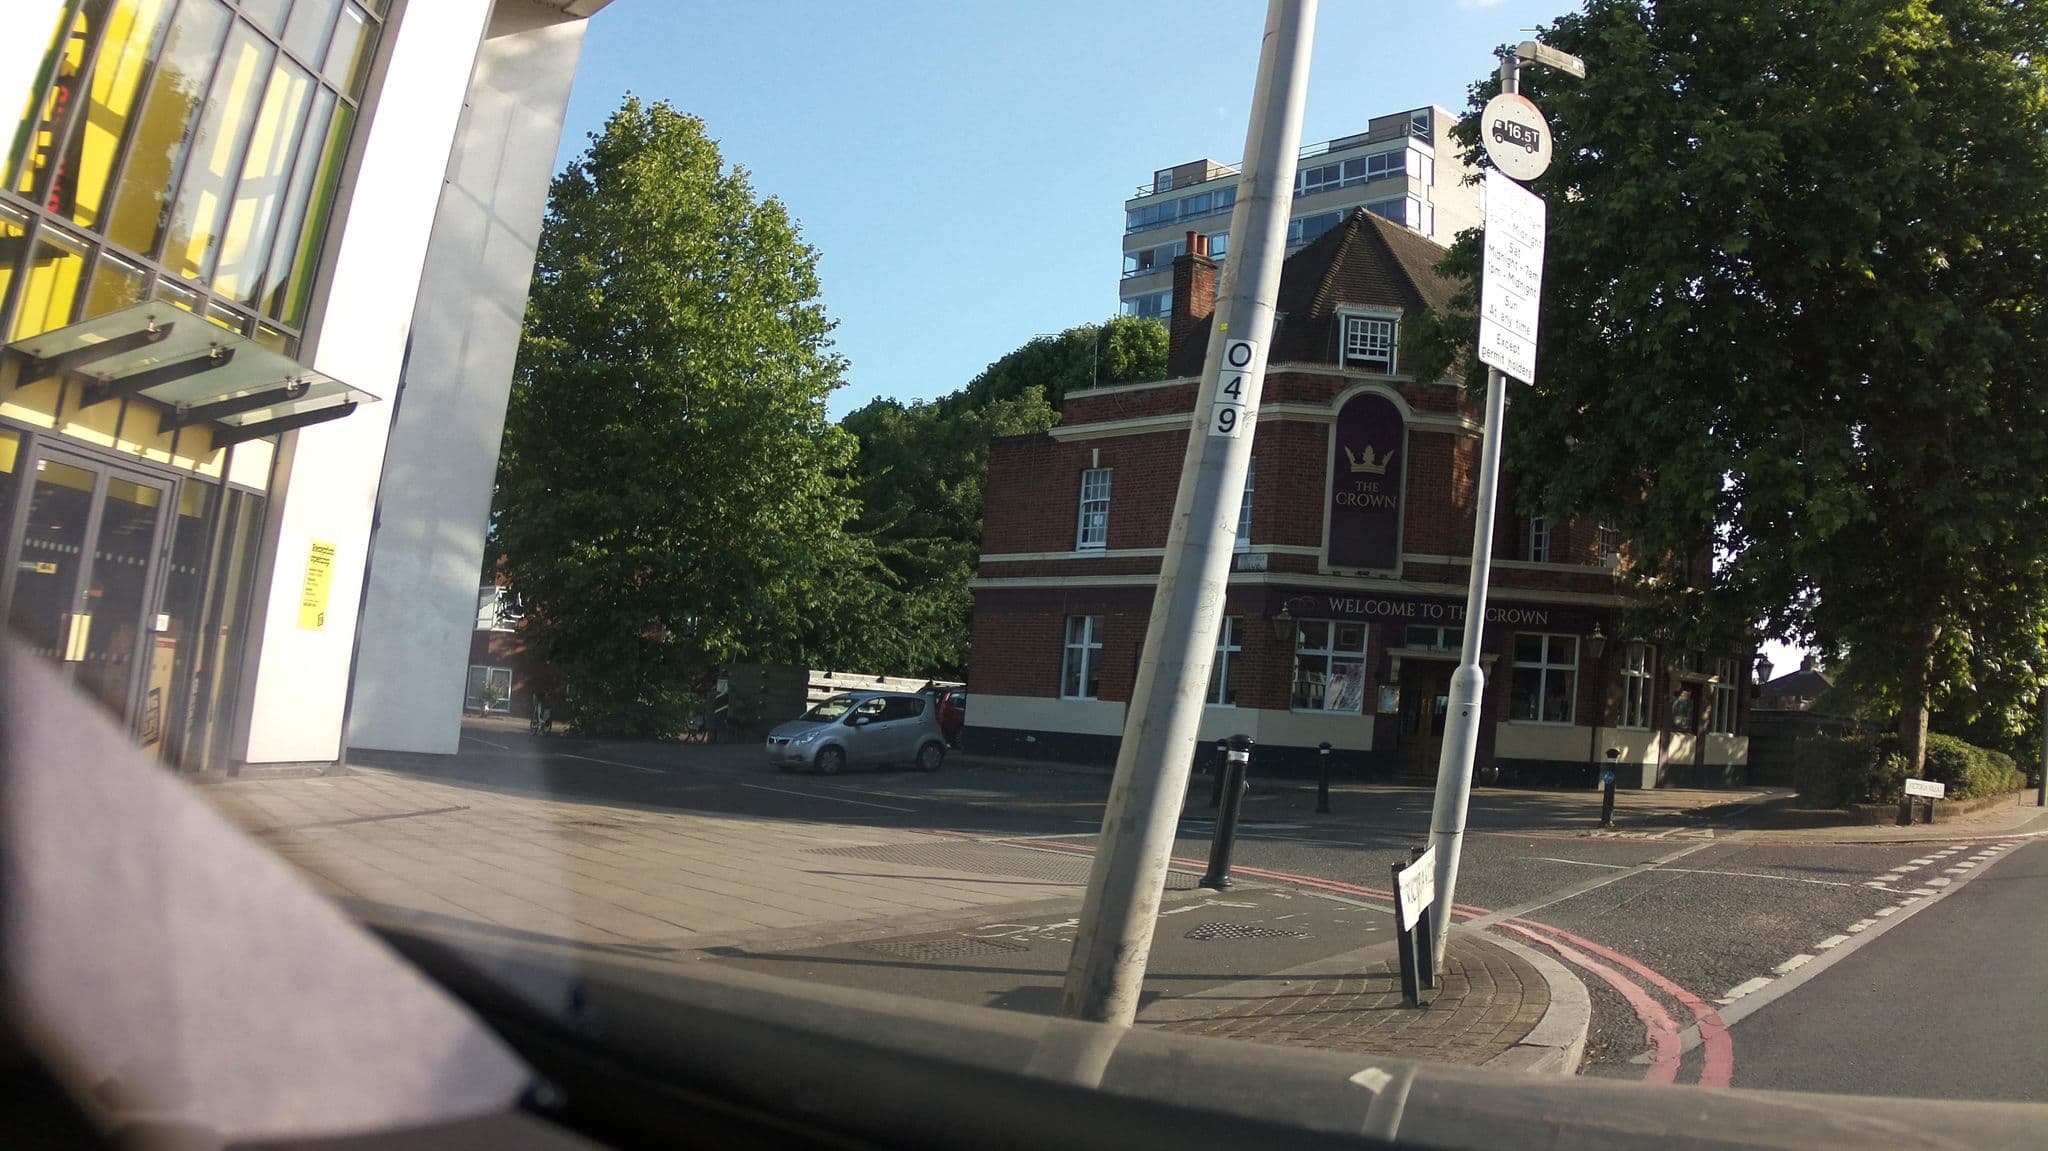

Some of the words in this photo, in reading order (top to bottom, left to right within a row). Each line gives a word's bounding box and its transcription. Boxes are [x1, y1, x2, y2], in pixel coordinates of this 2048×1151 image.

[1508, 123, 1539, 143] 16.5T
[1488, 244, 1518, 271] Midnight
[1525, 265, 1539, 281] 7am
[1509, 242, 1521, 259] Sat
[1508, 272, 1537, 298] Midnight
[1505, 295, 1518, 311] Sun
[1489, 304, 1498, 318] At
[1500, 312, 1512, 328] any
[1516, 319, 1531, 336] time
[1496, 333, 1521, 356] Except
[1481, 346, 1505, 365] permit
[1508, 357, 1533, 379] holders
[1218, 342, 1253, 433] 049
[1355, 480, 1380, 492] THE
[1335, 491, 1397, 510] CROWN
[1329, 597, 1416, 617] WELCOME
[1420, 603, 1444, 619] TO
[1485, 607, 1548, 625] CROWN
